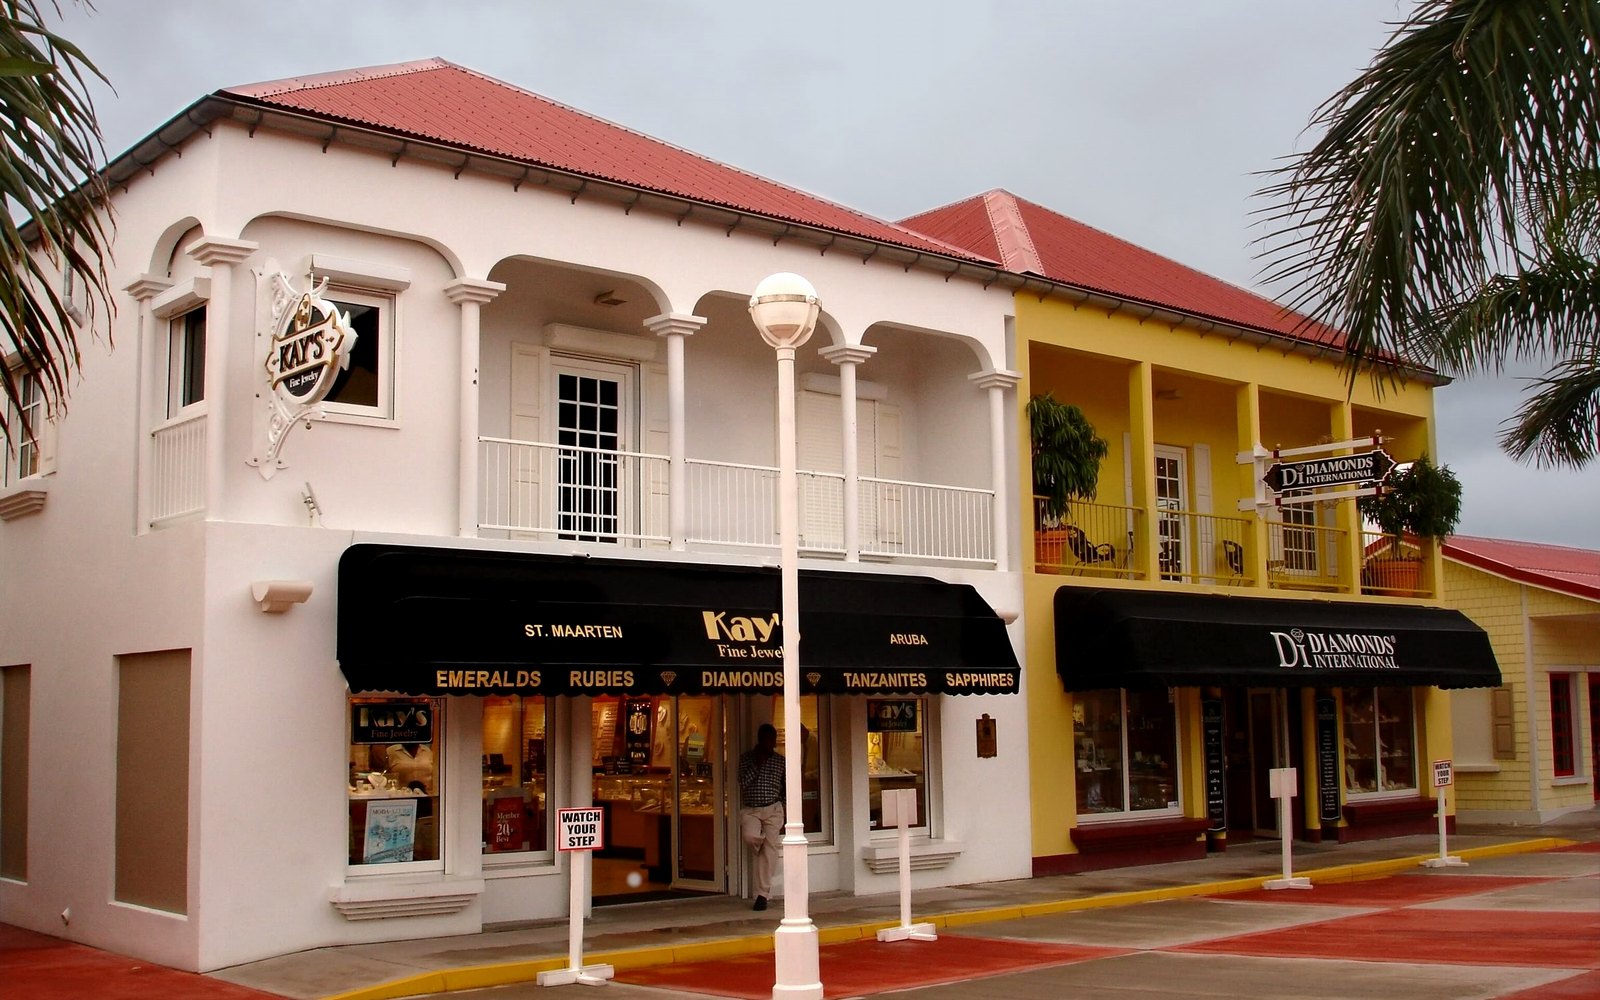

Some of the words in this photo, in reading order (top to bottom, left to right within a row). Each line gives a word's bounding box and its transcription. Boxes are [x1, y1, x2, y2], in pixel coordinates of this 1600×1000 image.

[279, 330, 325, 373] KAY'S
[290, 377, 301, 388] Fine
[301, 371, 319, 386] Jewelry
[1306, 456, 1374, 476] DIAMONDS
[1306, 469, 1374, 484] INTERNATIONAL
[524, 624, 549, 637] ST.
[551, 624, 623, 638] MAARTEN
[702, 611, 780, 643] Kay'
[890, 633, 929, 645] ARUBA
[717, 644, 748, 658] Fine
[750, 645, 785, 659] Jewel
[1313, 654, 1400, 669] INTERNATIONAL
[436, 670, 542, 688] EMERALDS
[569, 670, 635, 687] RUBIES
[702, 671, 784, 687] DIAMONDS
[843, 672, 928, 688] TANZANITES
[945, 672, 1014, 687] SAPPHIRES
[360, 707, 428, 728] Kay's
[370, 729, 389, 739] Fine
[390, 729, 419, 740] Jewelry
[1436, 769, 1449, 777] YOUR
[1437, 776, 1449, 785] STEP
[561, 811, 601, 823] WATCH
[567, 823, 596, 835] YOUR
[568, 835, 595, 847] STEP
